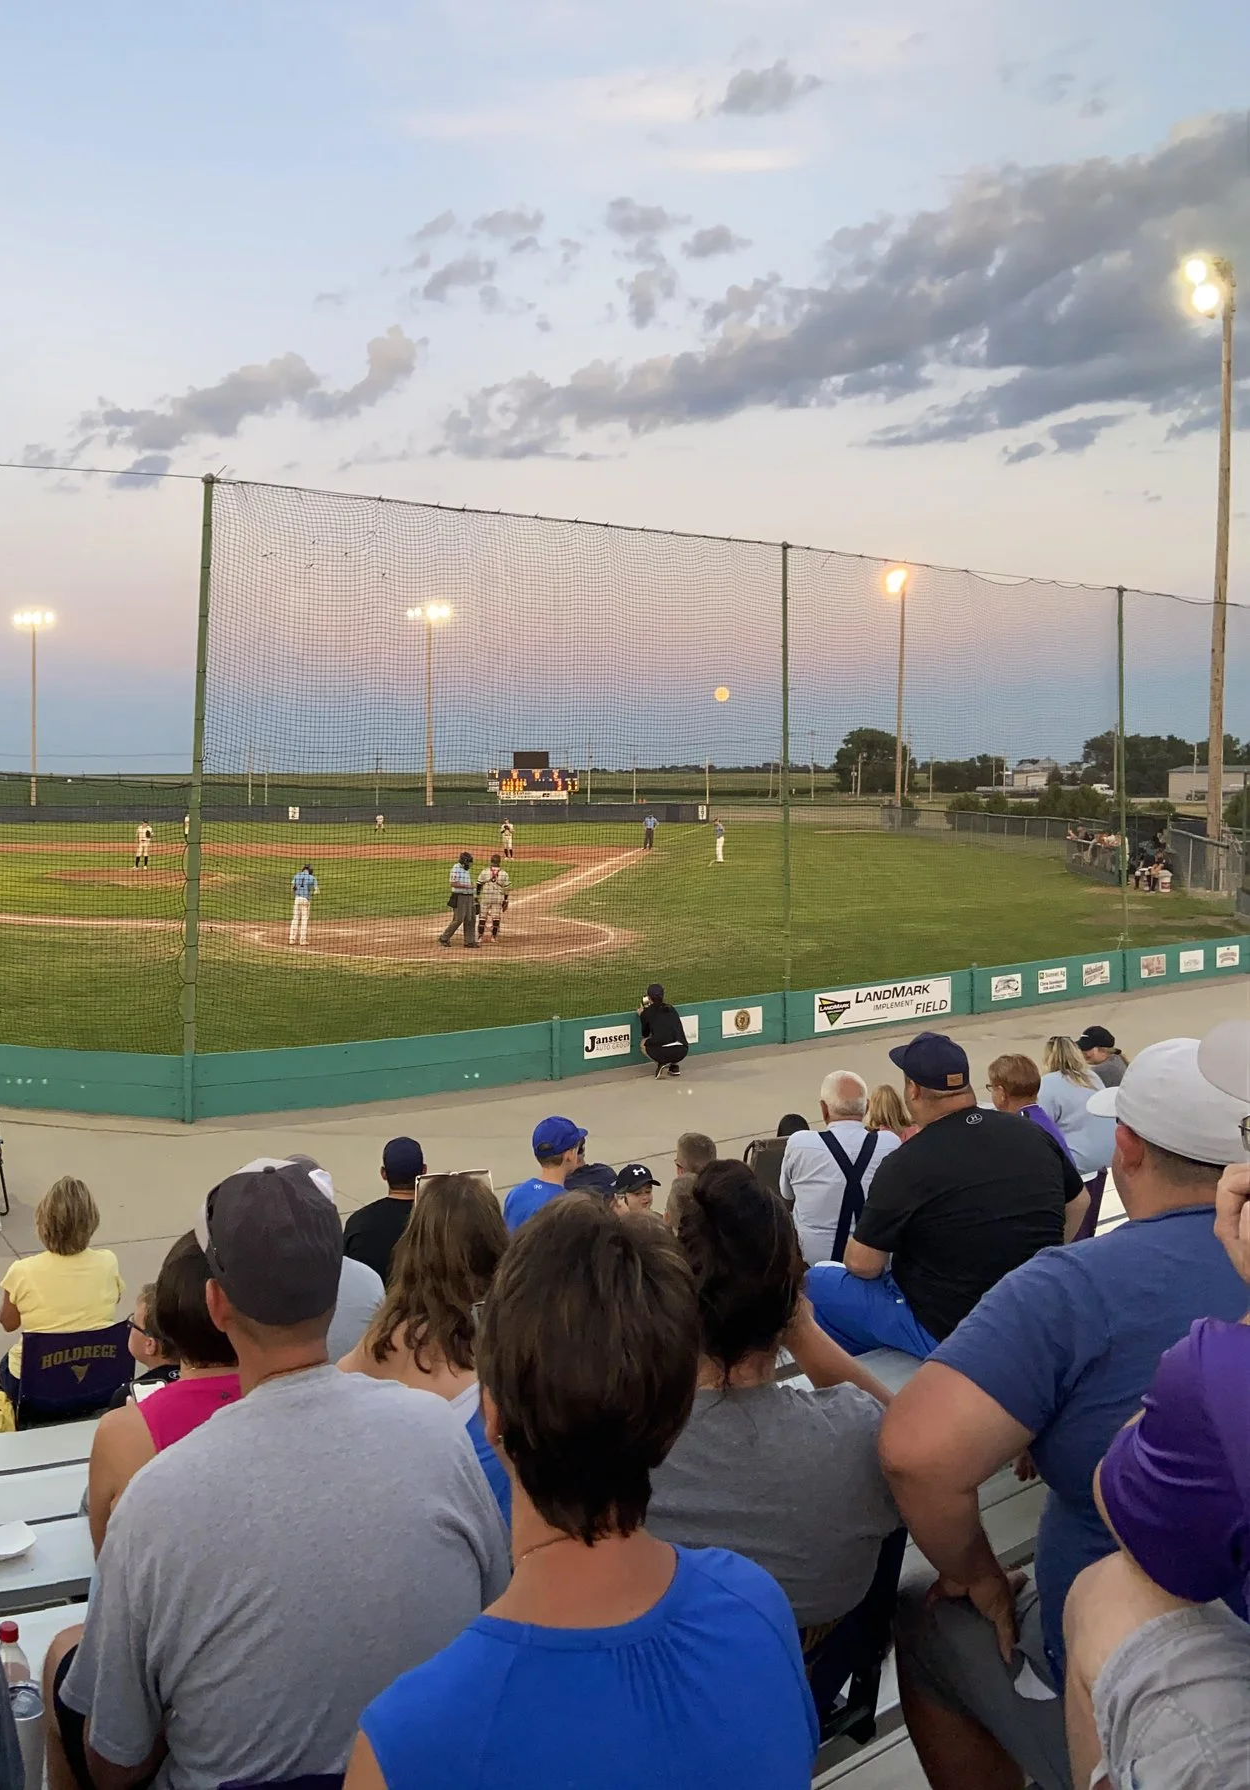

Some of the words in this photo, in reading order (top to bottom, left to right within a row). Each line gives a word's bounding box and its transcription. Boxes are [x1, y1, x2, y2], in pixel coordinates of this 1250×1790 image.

[873, 1000, 914, 1010] IMPLEMENT
[915, 999, 948, 1014] FIELD
[585, 1034, 630, 1052] Janssen
[40, 1344, 117, 1370] HOLDREGE
